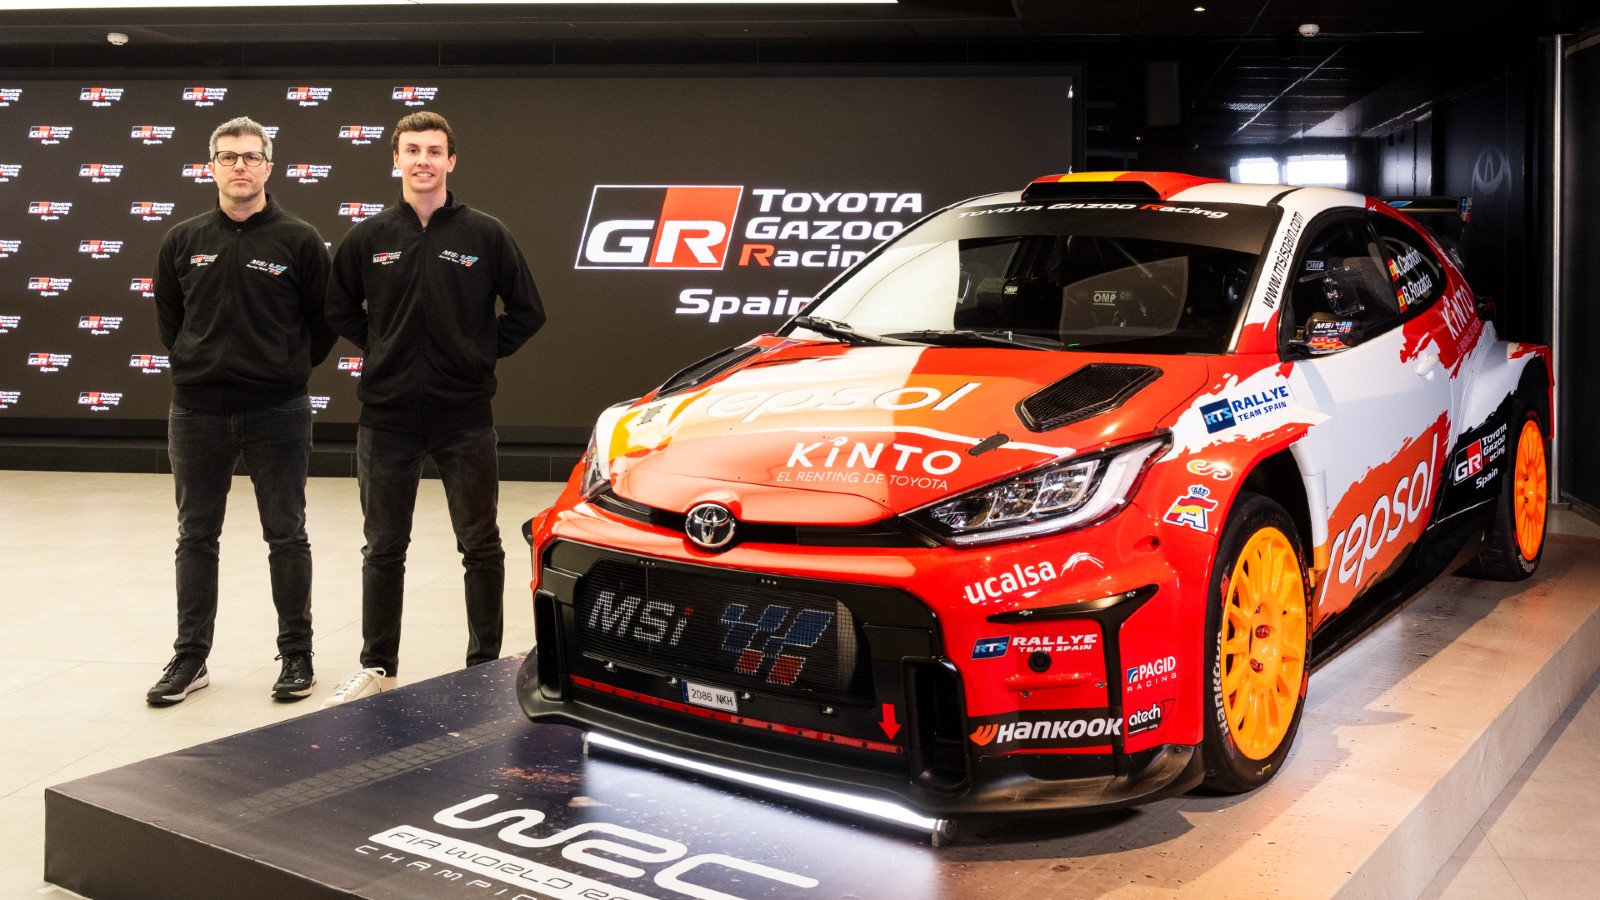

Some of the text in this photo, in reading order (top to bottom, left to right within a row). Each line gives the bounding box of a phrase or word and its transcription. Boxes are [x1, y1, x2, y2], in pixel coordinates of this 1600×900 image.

[752, 188, 922, 213] TOYOTA
[958, 205, 1043, 218] TOYOTA
[1140, 204, 1229, 219] Racing
[745, 217, 903, 240] GAZOO
[585, 219, 726, 263] GR
[738, 243, 866, 268] Racin
[1263, 211, 1304, 309] www.msispain.com
[1093, 293, 1117, 303] OMP
[707, 382, 982, 423] epsol
[1231, 385, 1289, 412] RALLYE
[1204, 407, 1233, 426] RTS
[1237, 401, 1287, 422] TEAM SPAIN
[1482, 422, 1507, 446] TOYOTA
[1455, 453, 1482, 482] GR
[1476, 468, 1498, 489] Spain
[776, 471, 948, 490] EL RENTING DE TOYOTA
[1318, 432, 1438, 607] repsol
[964, 560, 1057, 604] ucalsa
[975, 642, 1008, 653] RTS
[1012, 634, 1098, 646] RALLYE
[1056, 644, 1092, 652] SPAIN
[1140, 656, 1176, 680] PAGID
[1127, 673, 1177, 693] RACING
[691, 689, 733, 706] 2086 NKH
[1128, 703, 1161, 726] atech
[996, 717, 1123, 744] HANKOOK
[388, 832, 575, 890] FIA WORLD
